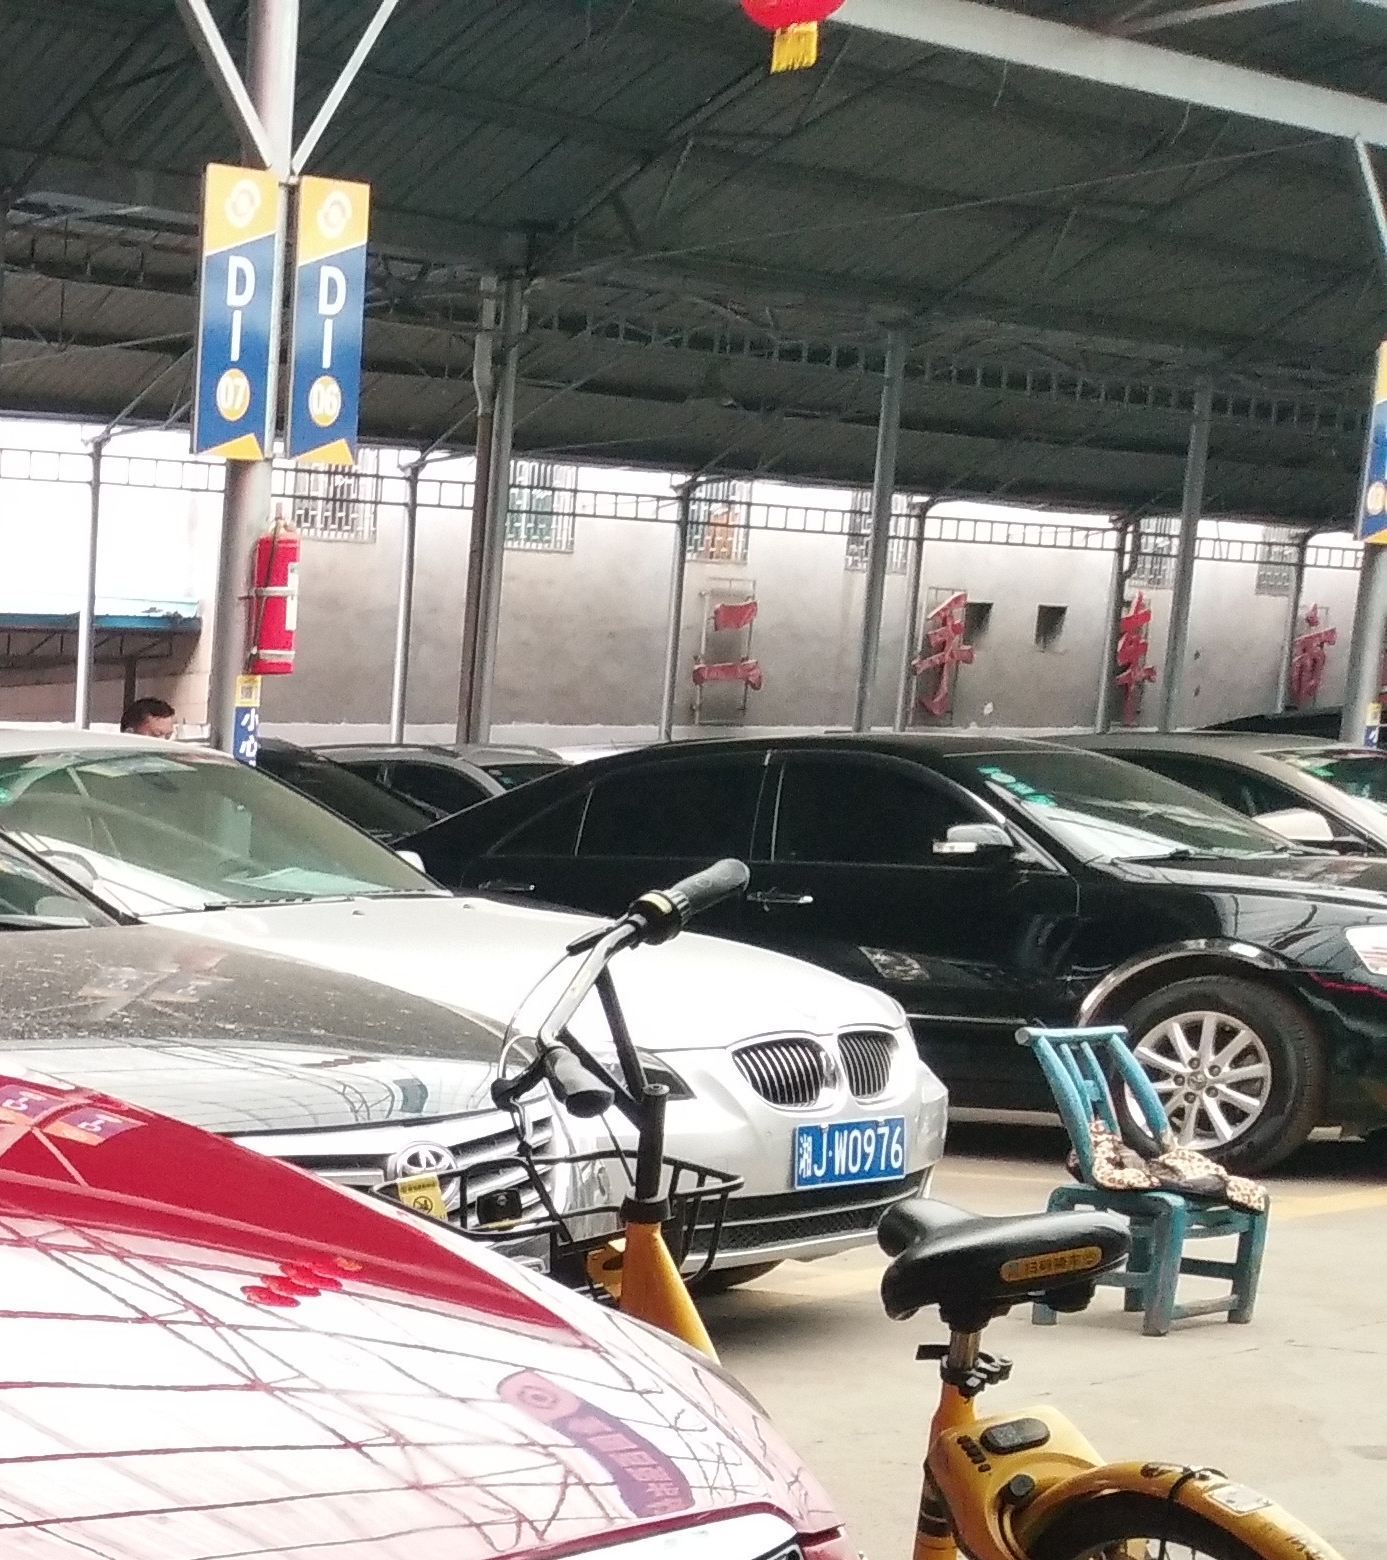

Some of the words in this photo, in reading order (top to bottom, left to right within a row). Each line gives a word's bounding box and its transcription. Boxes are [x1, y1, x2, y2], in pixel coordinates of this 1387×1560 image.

[220, 376, 245, 409] 07
[311, 382, 339, 415] 06
[239, 707, 261, 767] 小心
